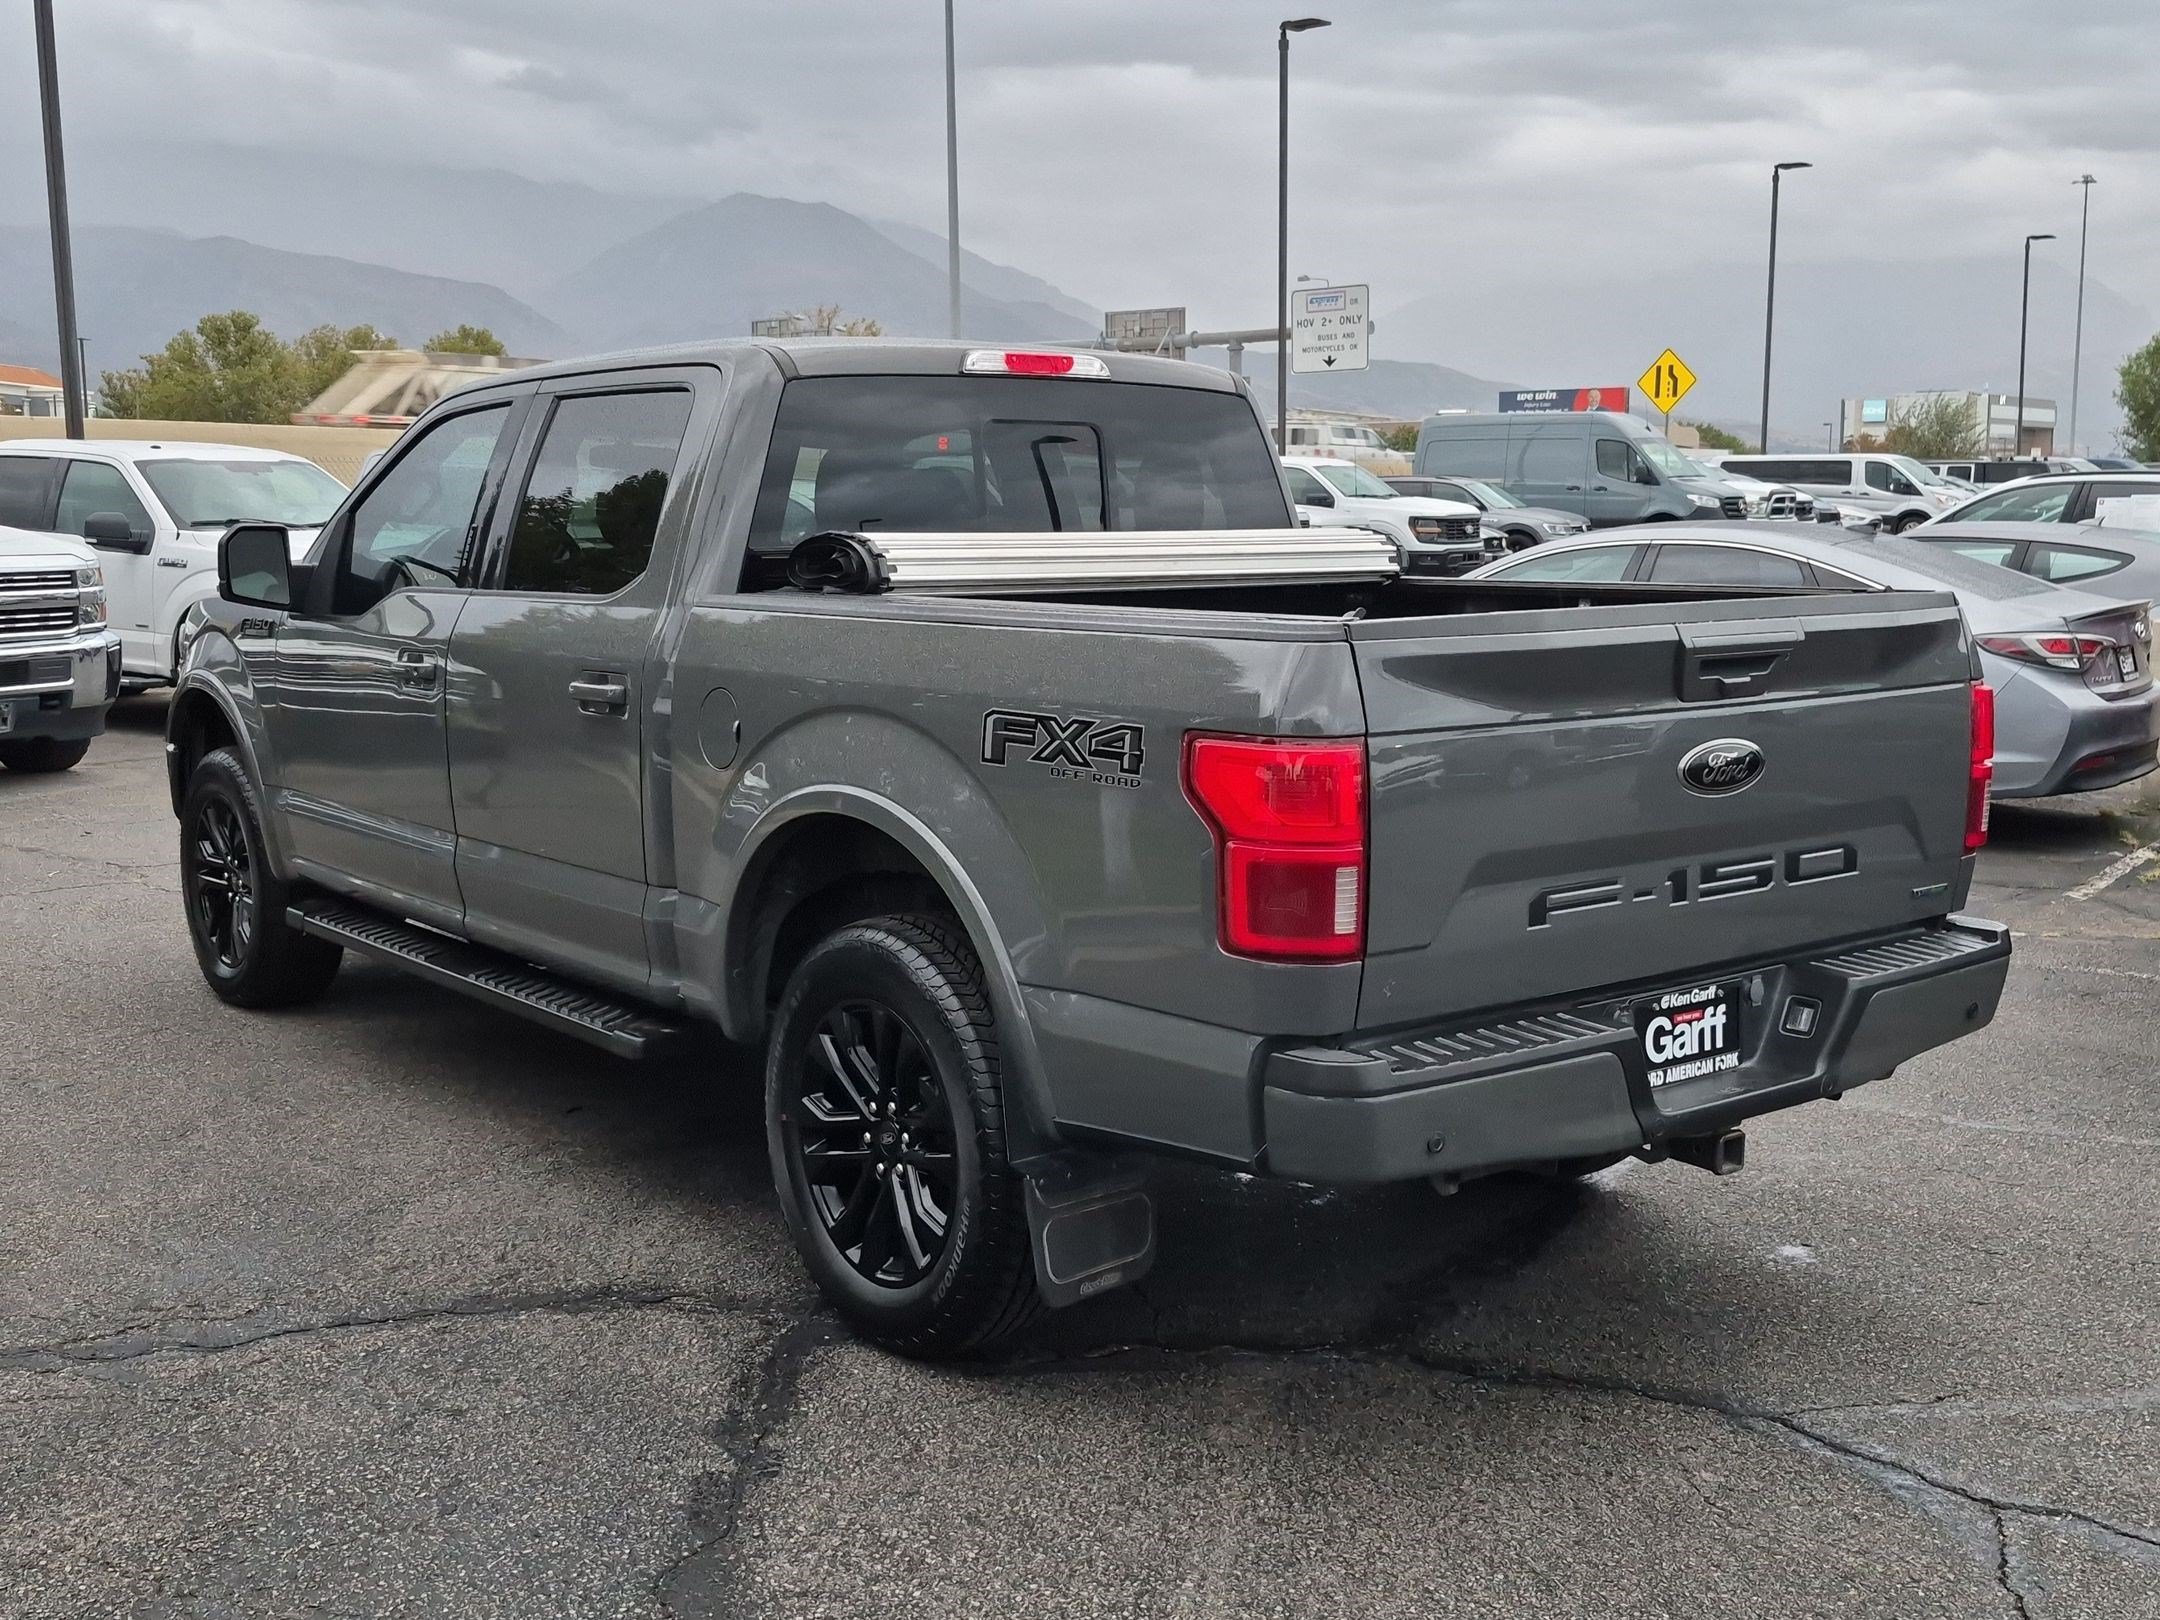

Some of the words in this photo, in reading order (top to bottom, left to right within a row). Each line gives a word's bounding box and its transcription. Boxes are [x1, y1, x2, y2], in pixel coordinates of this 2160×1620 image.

[1296, 318, 1315, 329] HOV
[1321, 316, 1332, 327] 2+
[1339, 314, 1363, 326] ONLY
[1317, 333, 1338, 342] BUSES
[1342, 331, 1356, 339] AND
[1302, 344, 1345, 355] MOTORCYCLES
[1516, 392, 1534, 401] we
[1535, 390, 1557, 401] win
[980, 707, 1145, 778] FX4
[1049, 766, 1086, 781] OFF
[1091, 772, 1143, 790] ROAD
[1702, 751, 1750, 785] Ford
[1526, 843, 1860, 931] F-150
[1645, 1003, 1727, 1064] Garff
[1665, 1058, 1714, 1084] AMERICAN
[1715, 1051, 1739, 1072] FORK
[932, 1213, 969, 1303] Hankoo
